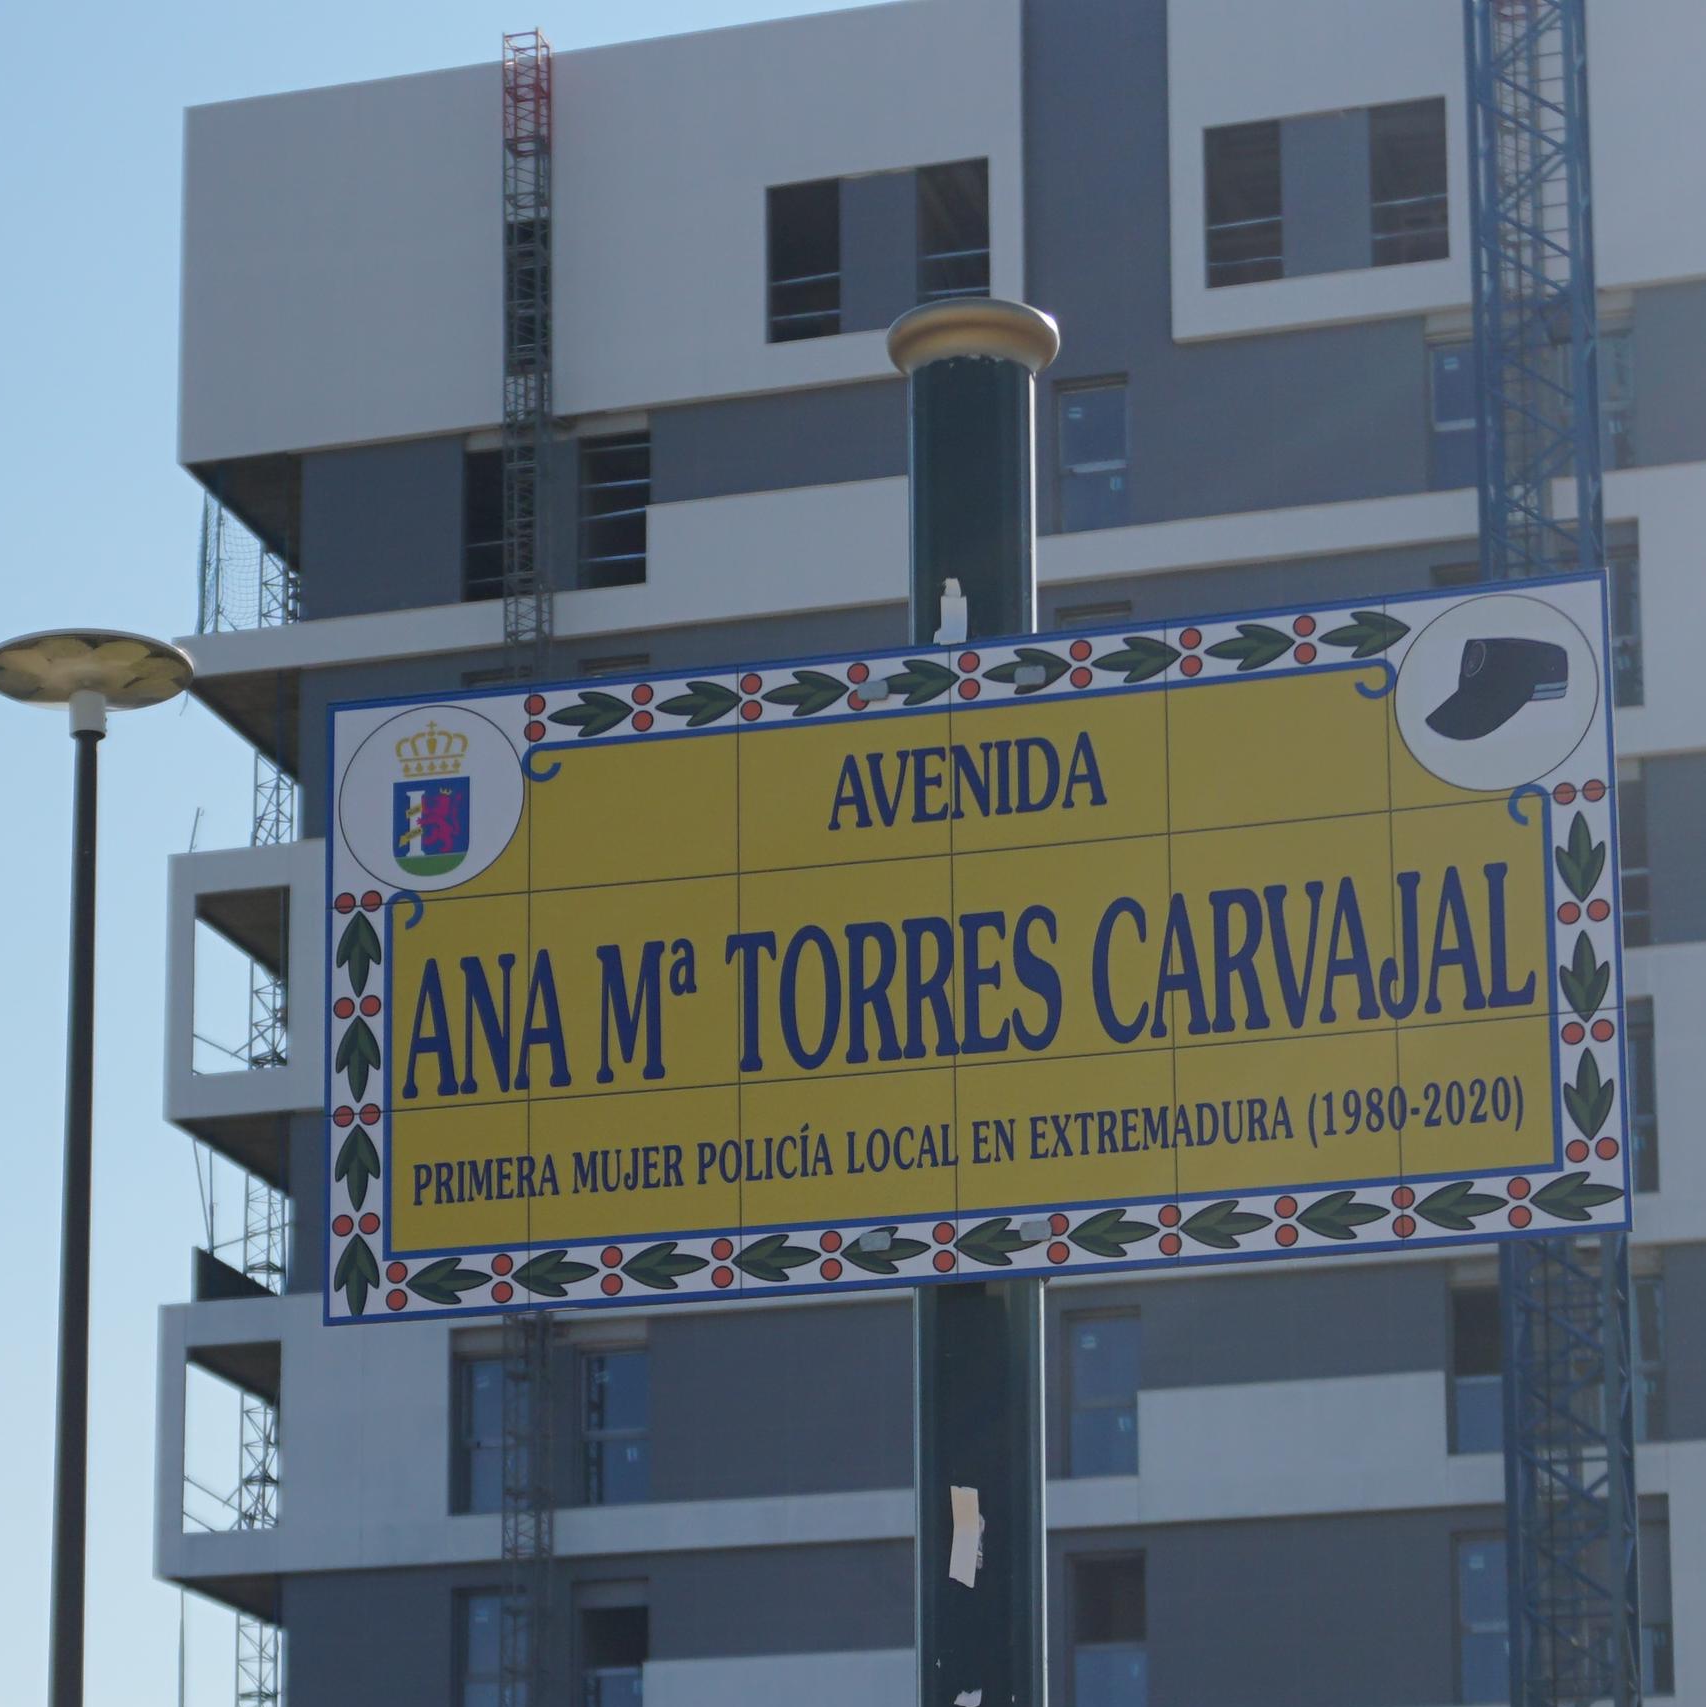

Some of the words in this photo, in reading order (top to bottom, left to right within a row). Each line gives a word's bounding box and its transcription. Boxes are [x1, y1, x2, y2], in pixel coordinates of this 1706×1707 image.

[828, 731, 1107, 831] AVENIDA
[402, 949, 572, 1099] ANA
[596, 938, 697, 1084] Mª
[725, 904, 1063, 1073] TORRES
[1092, 862, 1537, 1044] CARVAJAL
[413, 1154, 560, 1206] PRIMERA
[572, 1144, 684, 1194] MUJER
[697, 1123, 834, 1184] POLICÍA
[846, 1122, 959, 1174] LOCAL
[972, 1118, 1015, 1165] EN
[1029, 1096, 1293, 1159] EXTREMADURA
[1308, 1075, 1524, 1149] (1980-2020)
